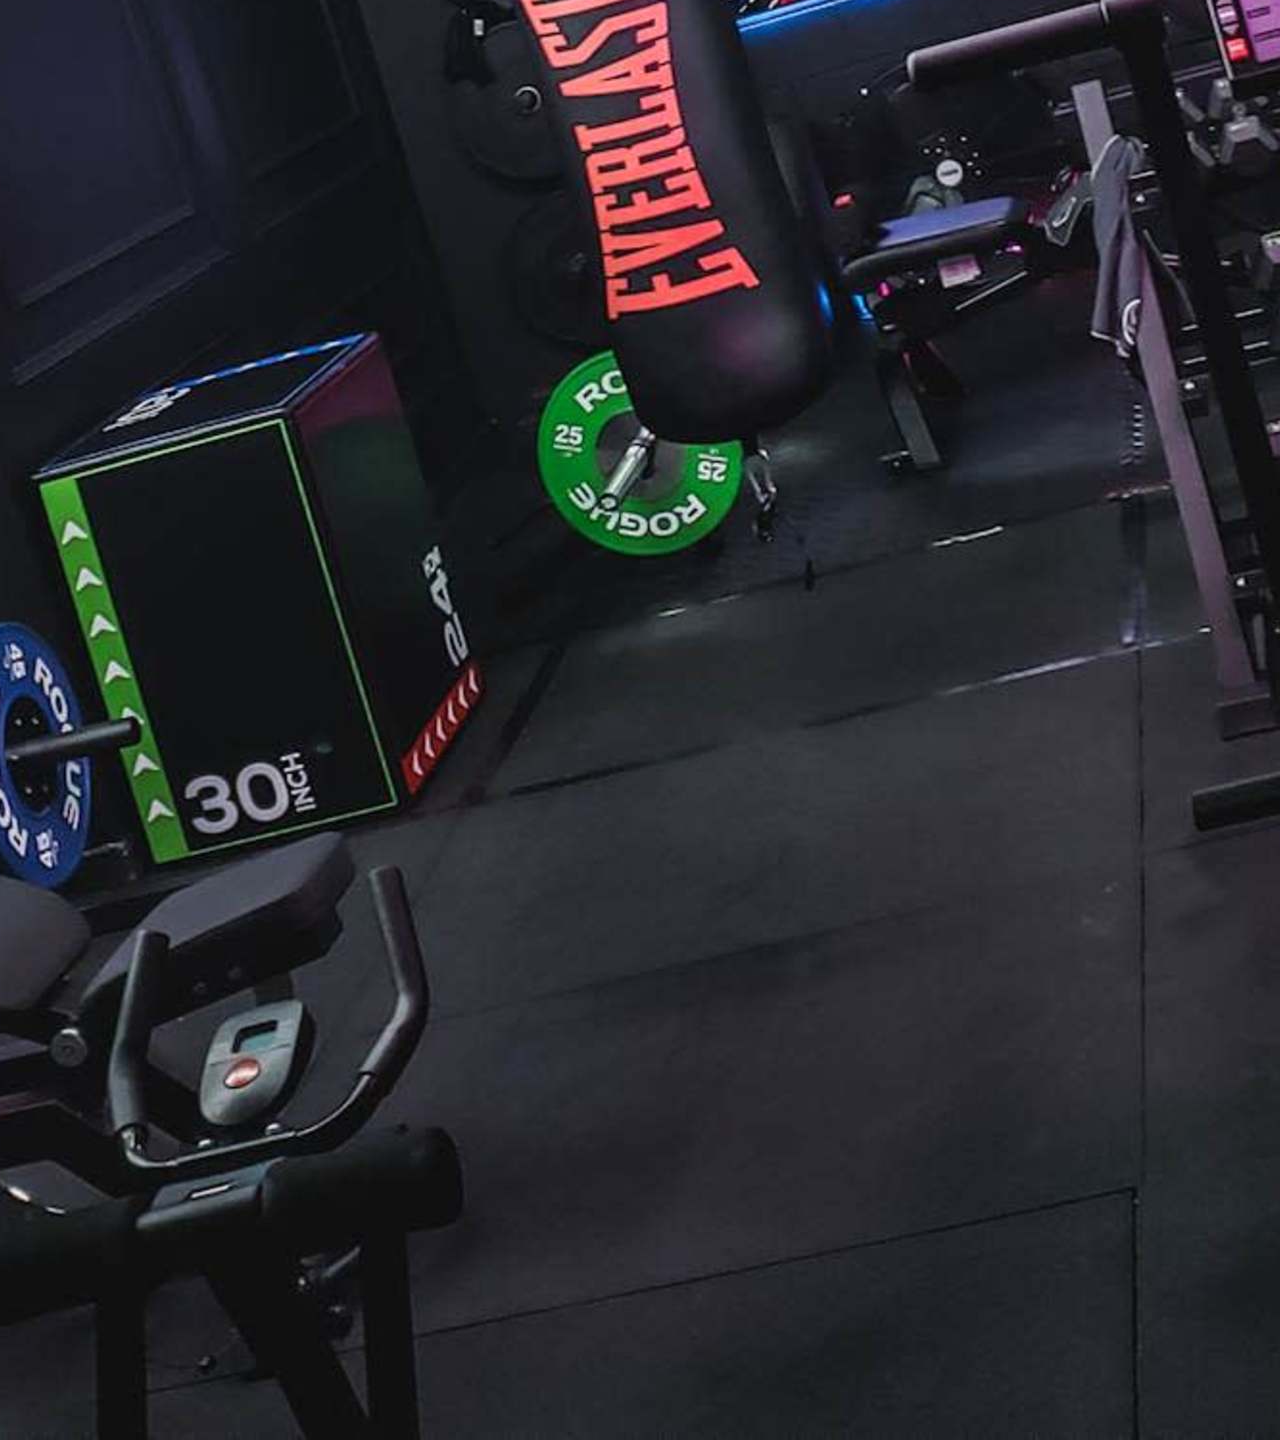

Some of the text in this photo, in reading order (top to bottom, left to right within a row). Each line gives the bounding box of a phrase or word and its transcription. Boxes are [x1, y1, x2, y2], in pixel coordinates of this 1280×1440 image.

[554, 424, 584, 447] 25
[697, 460, 728, 483] 25
[34, 657, 81, 830] ROUE
[185, 761, 291, 835] 30
[281, 752, 317, 815] INCH
